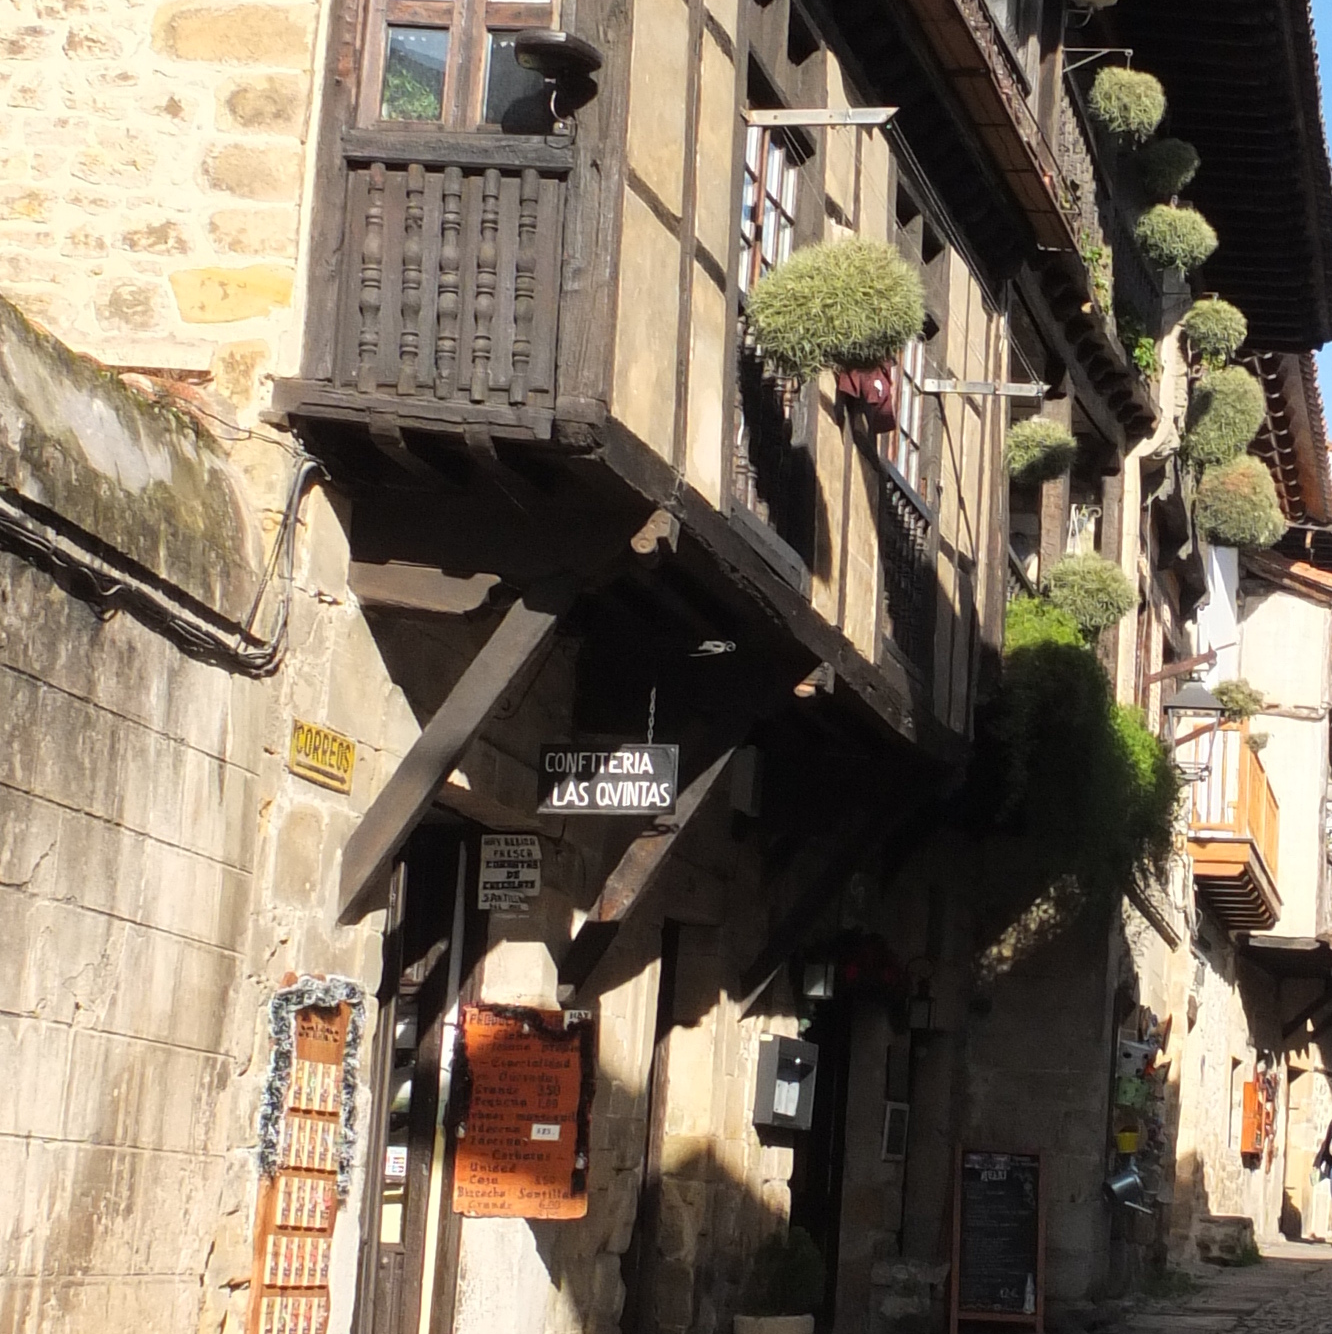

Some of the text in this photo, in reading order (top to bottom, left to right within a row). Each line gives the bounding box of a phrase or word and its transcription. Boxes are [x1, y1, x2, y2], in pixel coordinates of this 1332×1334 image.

[296, 724, 351, 774] CORREOS
[545, 752, 654, 775] CONFITERIA
[552, 781, 670, 806] LAS QVINTAS
